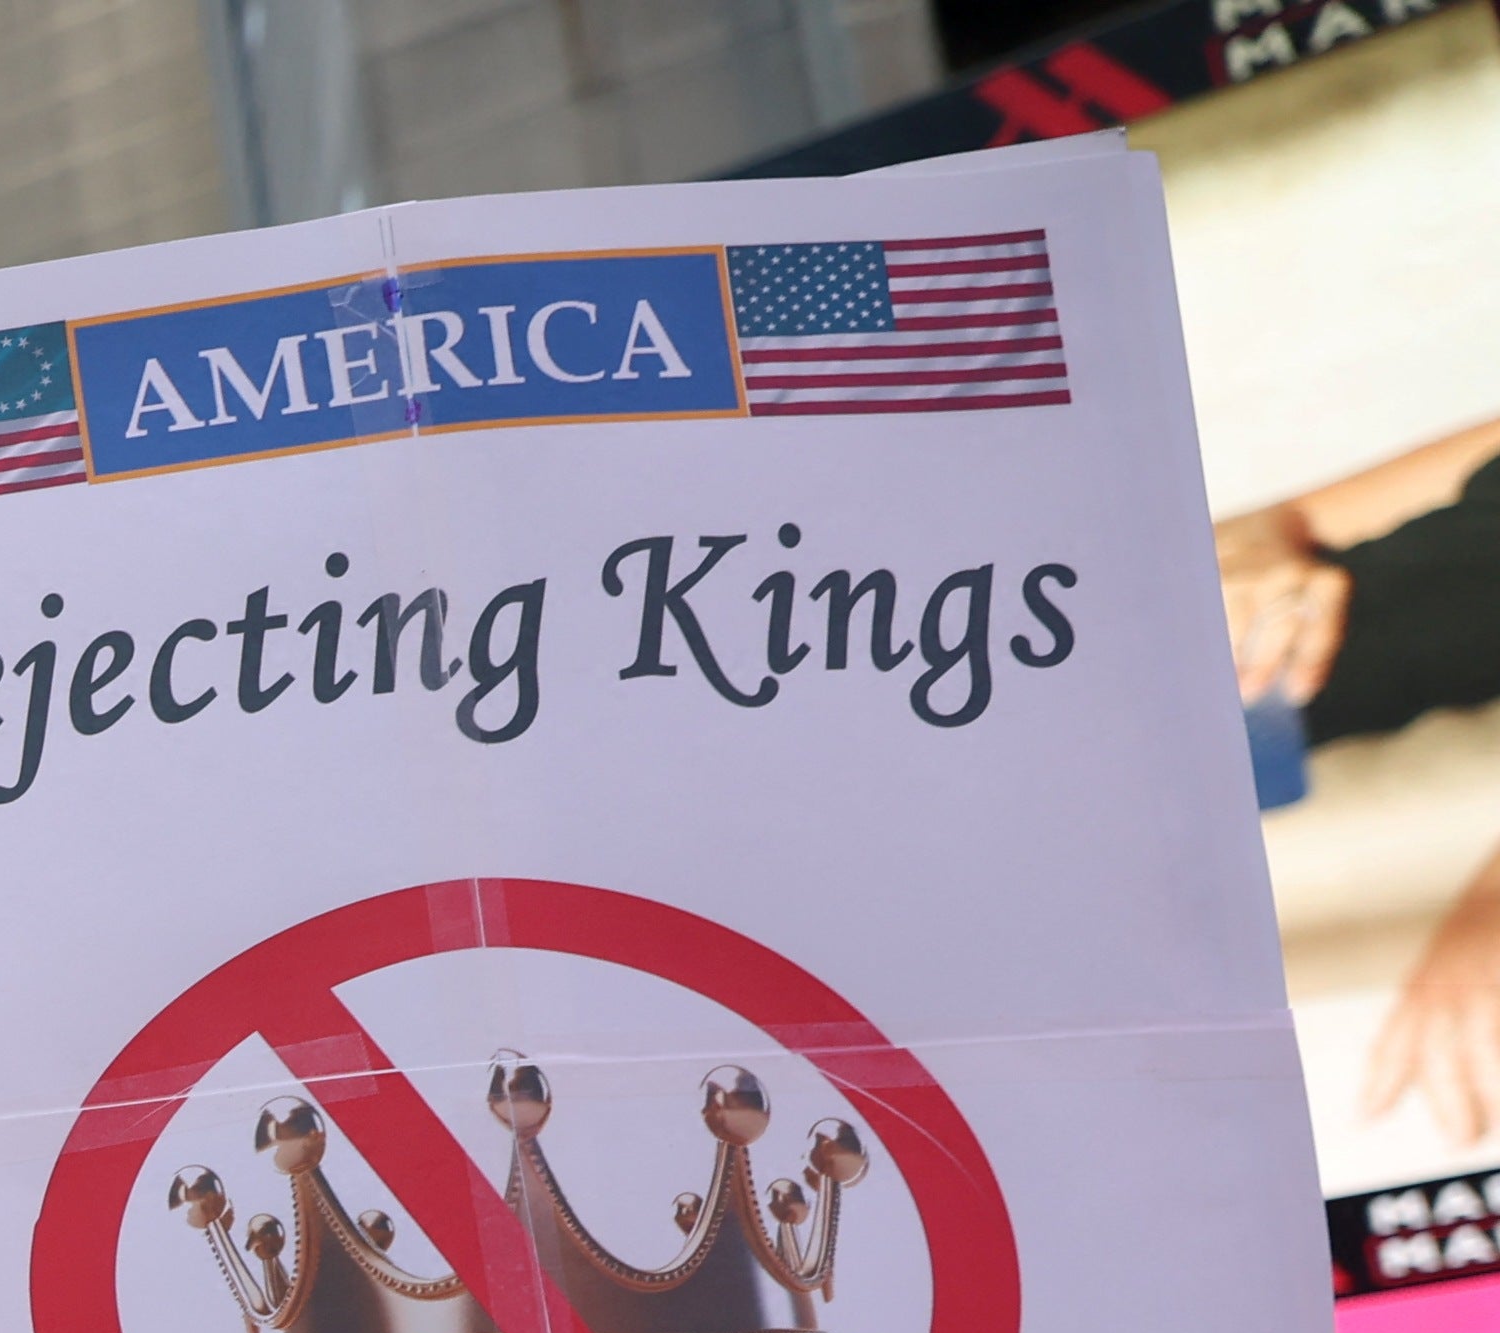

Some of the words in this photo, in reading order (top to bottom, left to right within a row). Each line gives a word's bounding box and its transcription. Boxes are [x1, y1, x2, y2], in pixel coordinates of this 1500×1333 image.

[123, 298, 693, 439] AMERICA
[600, 523, 1077, 727] Kings
[1378, 1214, 1500, 1279] MA
